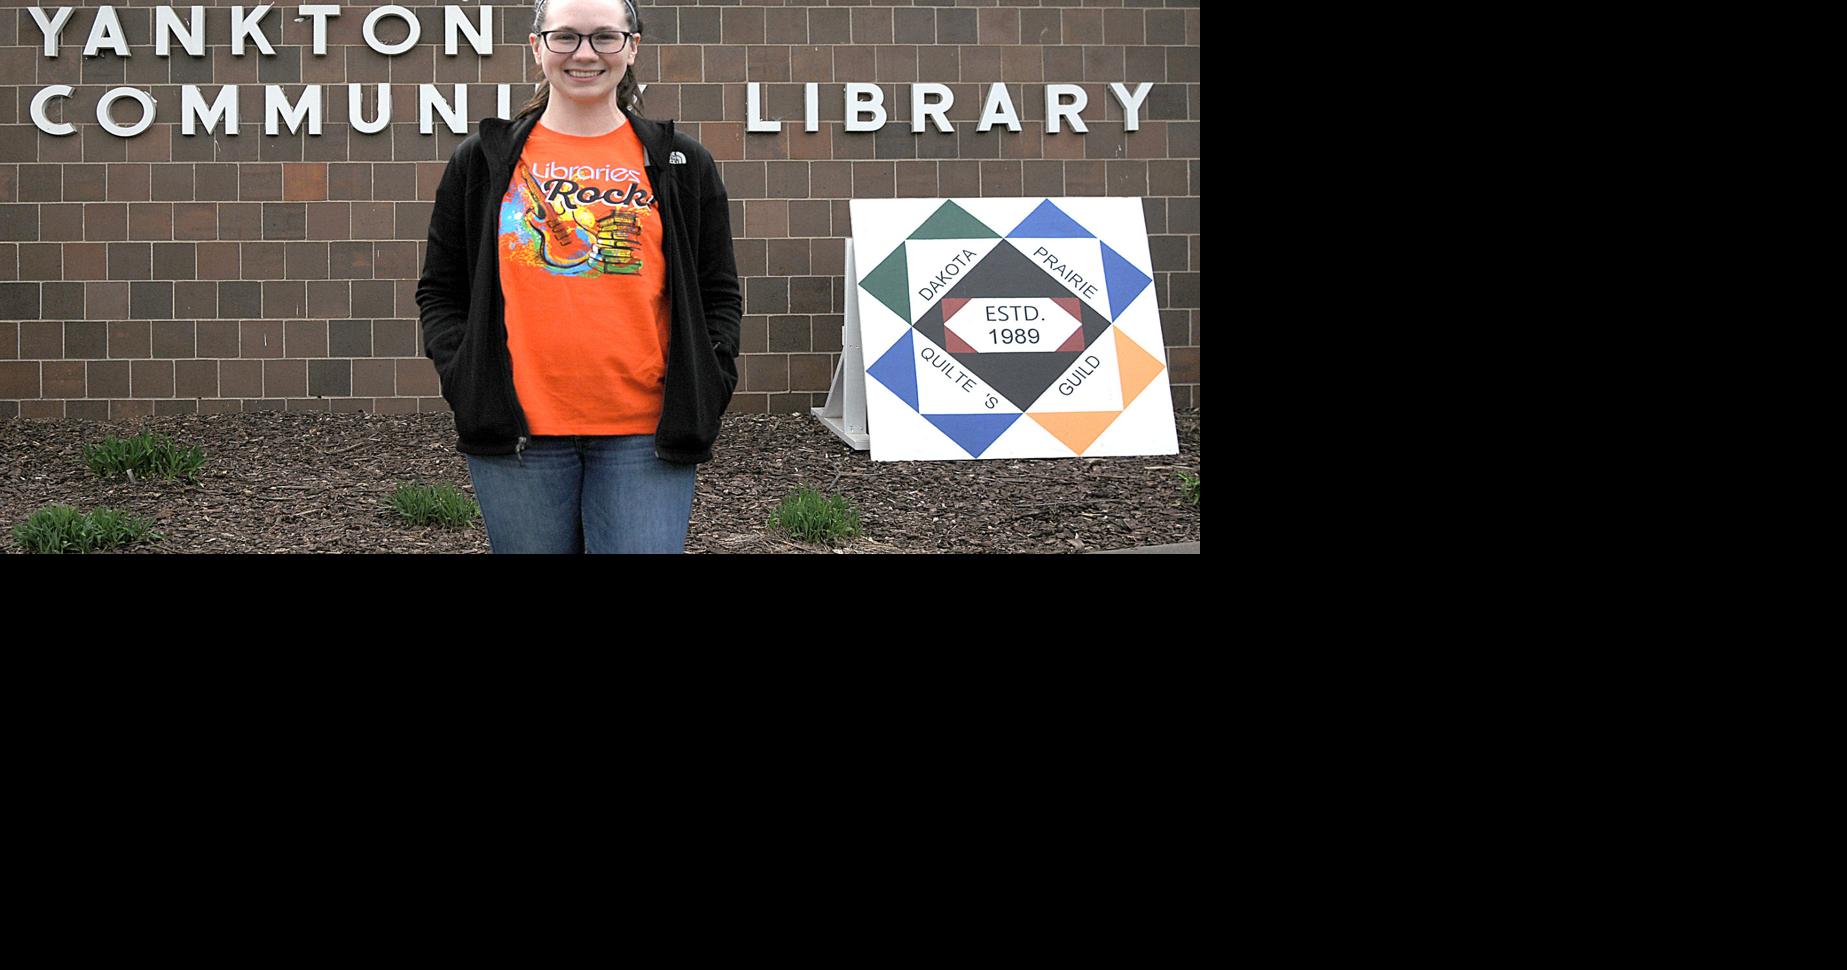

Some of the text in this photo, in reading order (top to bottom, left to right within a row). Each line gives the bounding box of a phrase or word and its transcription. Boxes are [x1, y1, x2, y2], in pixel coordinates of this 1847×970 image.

[27, 5, 494, 56] YANKTON
[746, 82, 1154, 133] LIBRARY
[532, 161, 641, 184] Libraries
[918, 246, 1098, 301] DAKOTA PRAIRIE
[985, 305, 1046, 322] ESTD.
[988, 328, 1041, 345] 1989
[1058, 354, 1101, 397] GUILD
